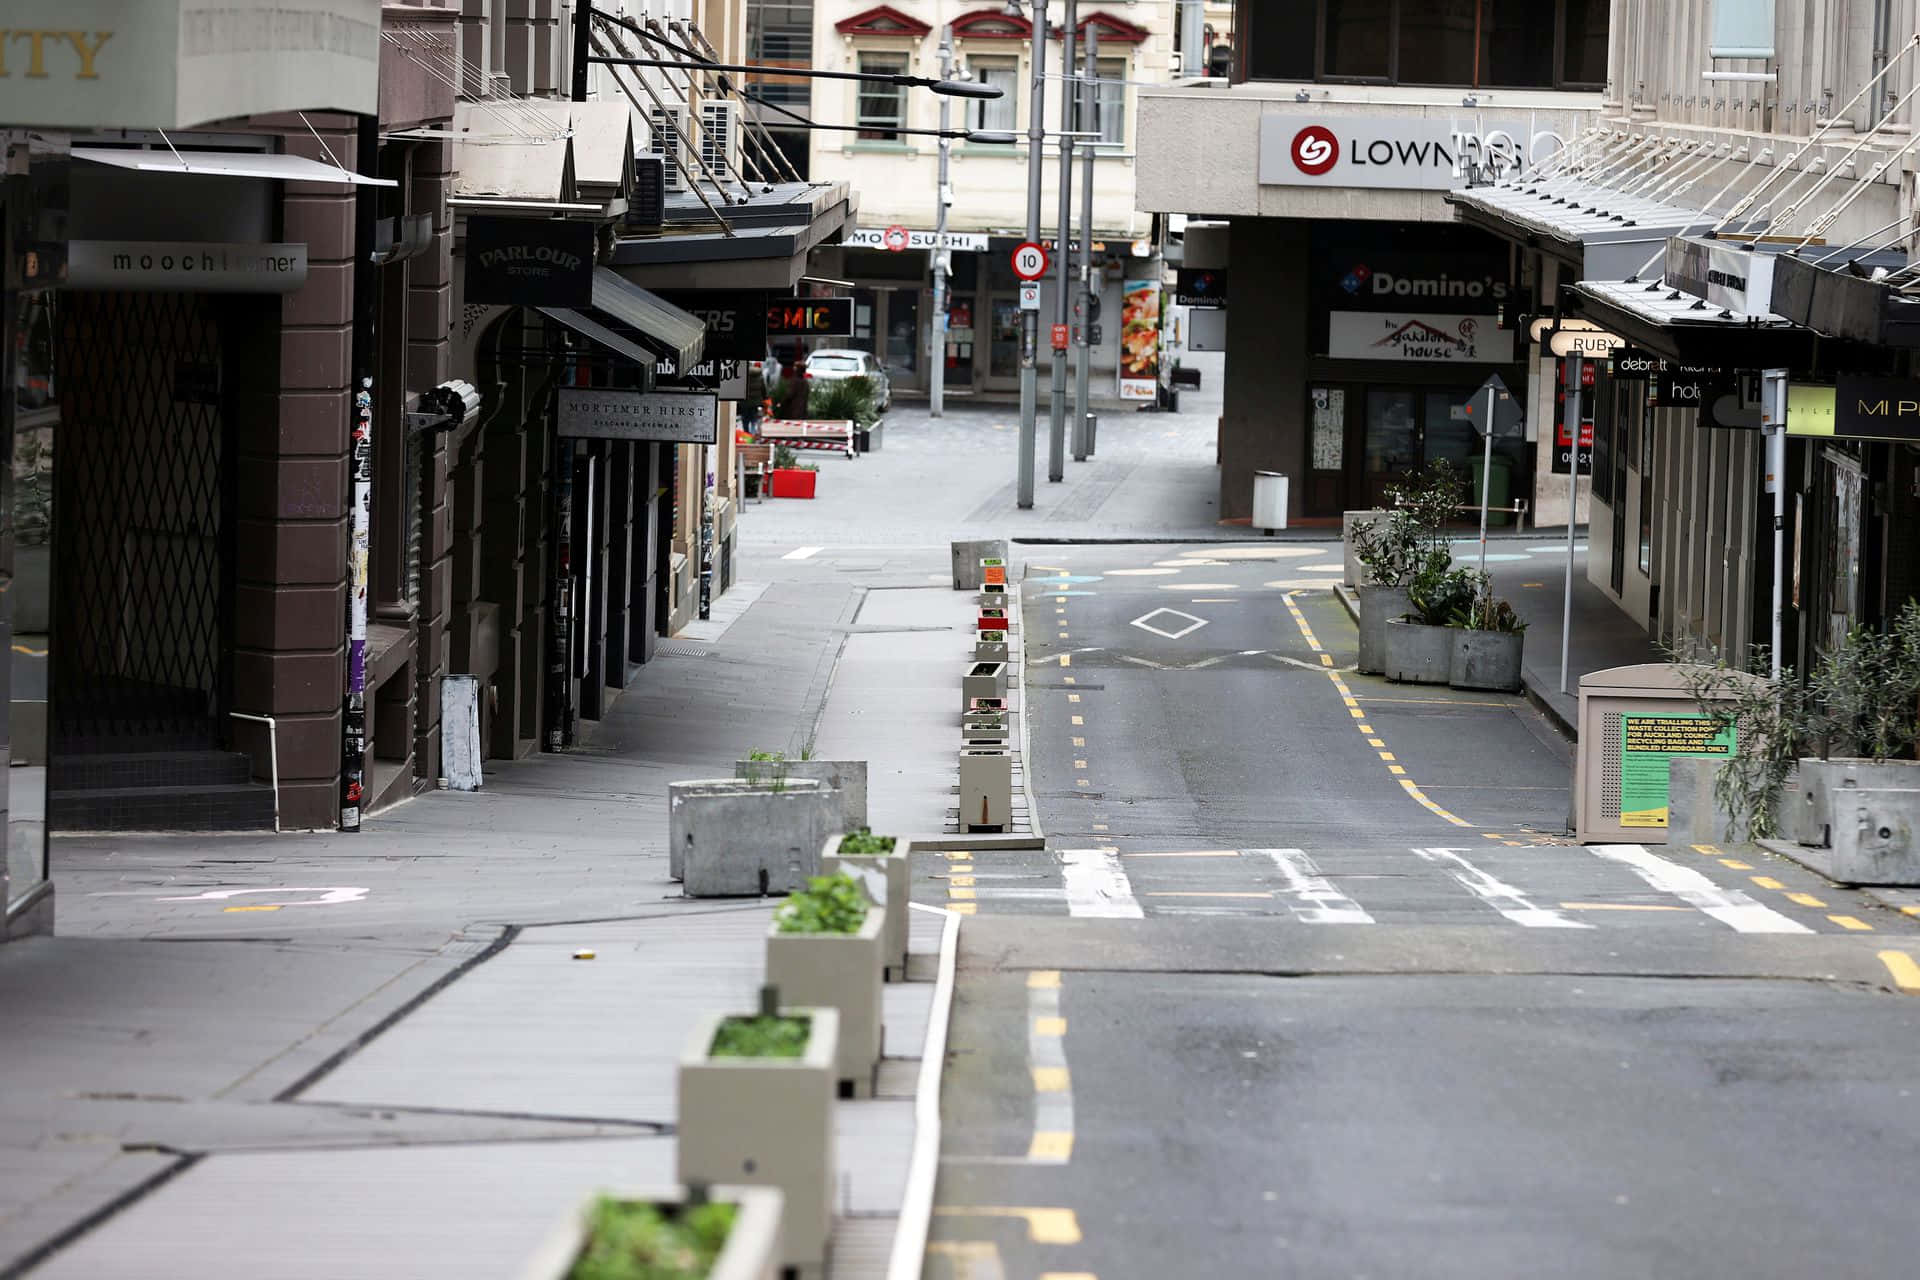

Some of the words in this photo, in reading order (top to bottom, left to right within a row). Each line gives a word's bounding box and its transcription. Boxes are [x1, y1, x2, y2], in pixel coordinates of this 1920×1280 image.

[480, 246, 582, 272] PARLOUR
[1023, 254, 1037, 269] 10
[506, 266, 552, 278] STORE
[1372, 273, 1507, 298] Domino's
[1573, 338, 1618, 352] RUBY
[1620, 357, 1668, 372] debrett
[568, 403, 651, 415] MORTIMER
[659, 406, 705, 417] HIRST
[1858, 399, 1889, 416] MI
